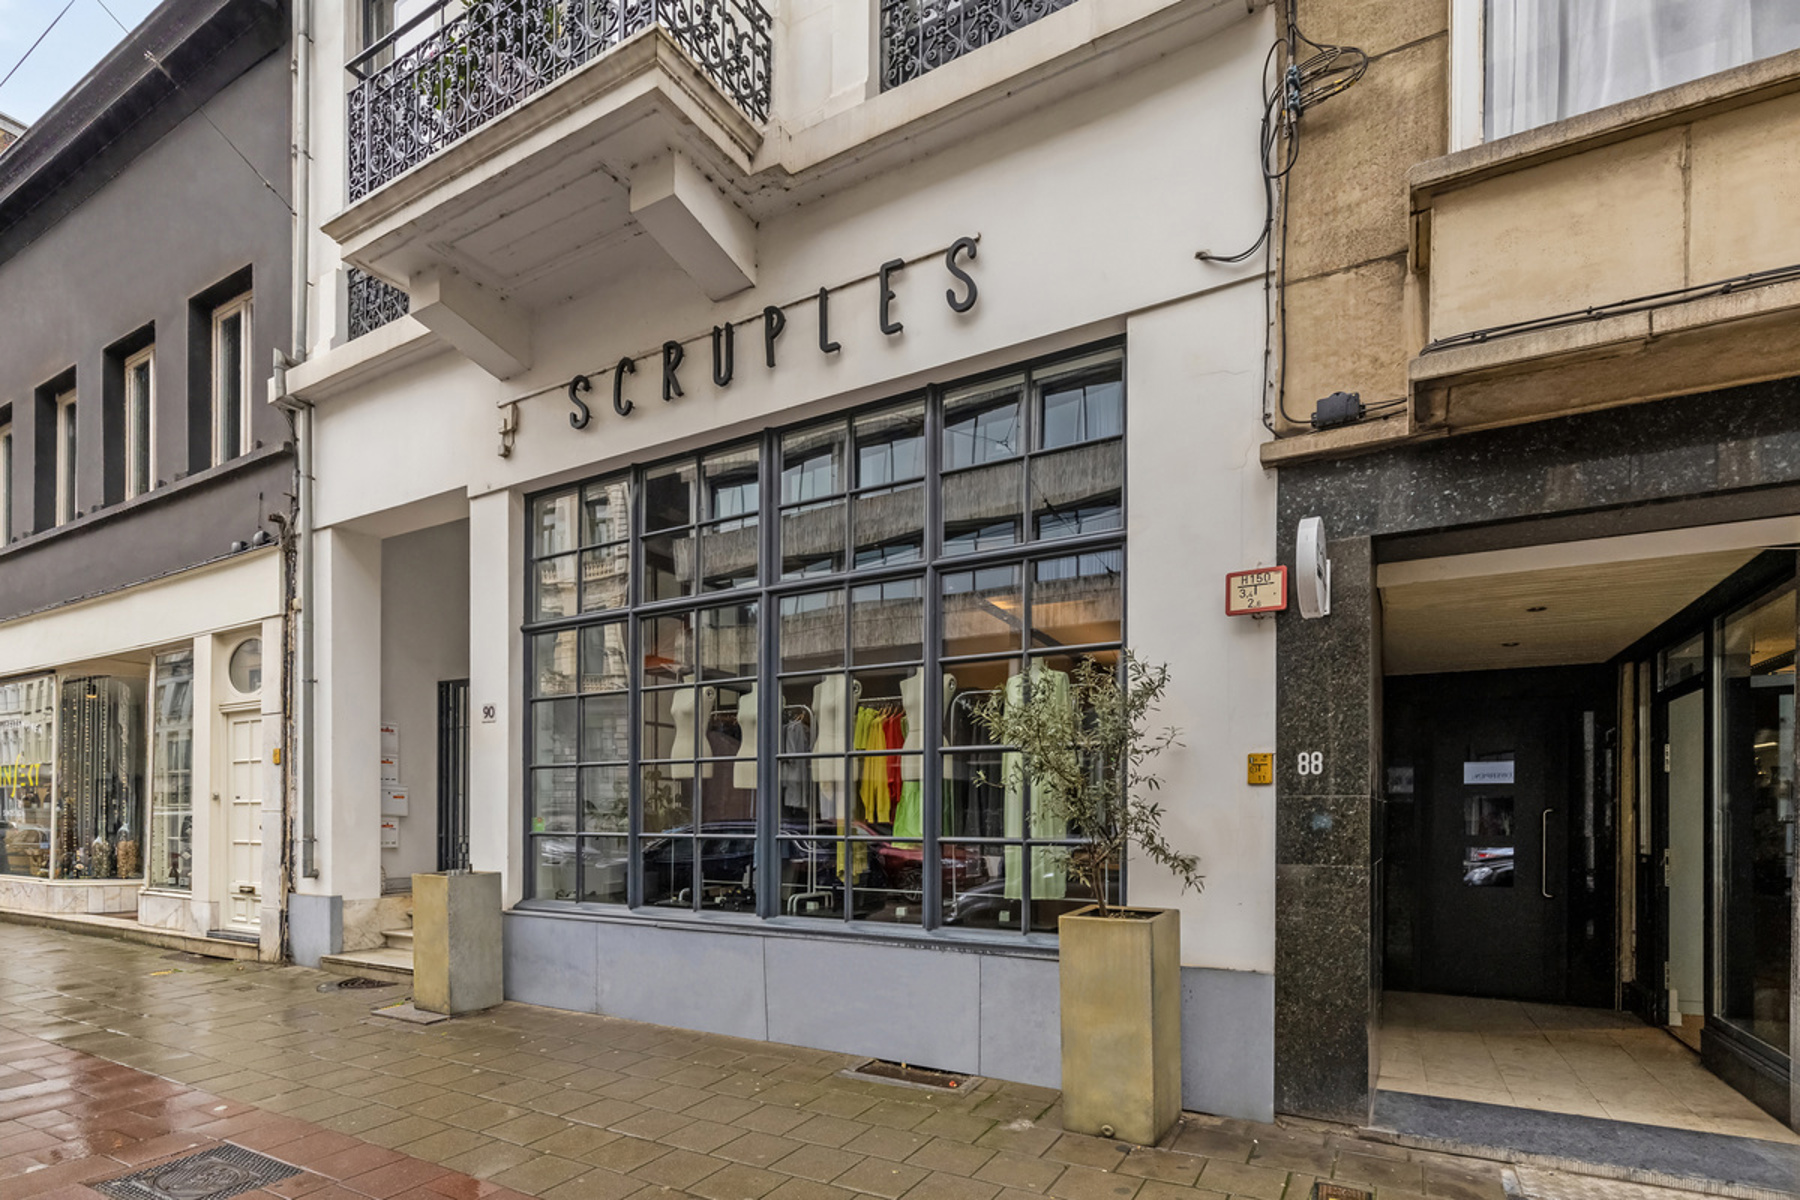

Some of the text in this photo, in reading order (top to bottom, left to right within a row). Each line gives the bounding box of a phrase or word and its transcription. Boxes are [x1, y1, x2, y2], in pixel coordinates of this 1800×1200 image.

[568, 236, 978, 430] SCRUPLES
[1241, 571, 1272, 585] H150
[482, 705, 496, 719] 90
[1297, 751, 1324, 776] 88
